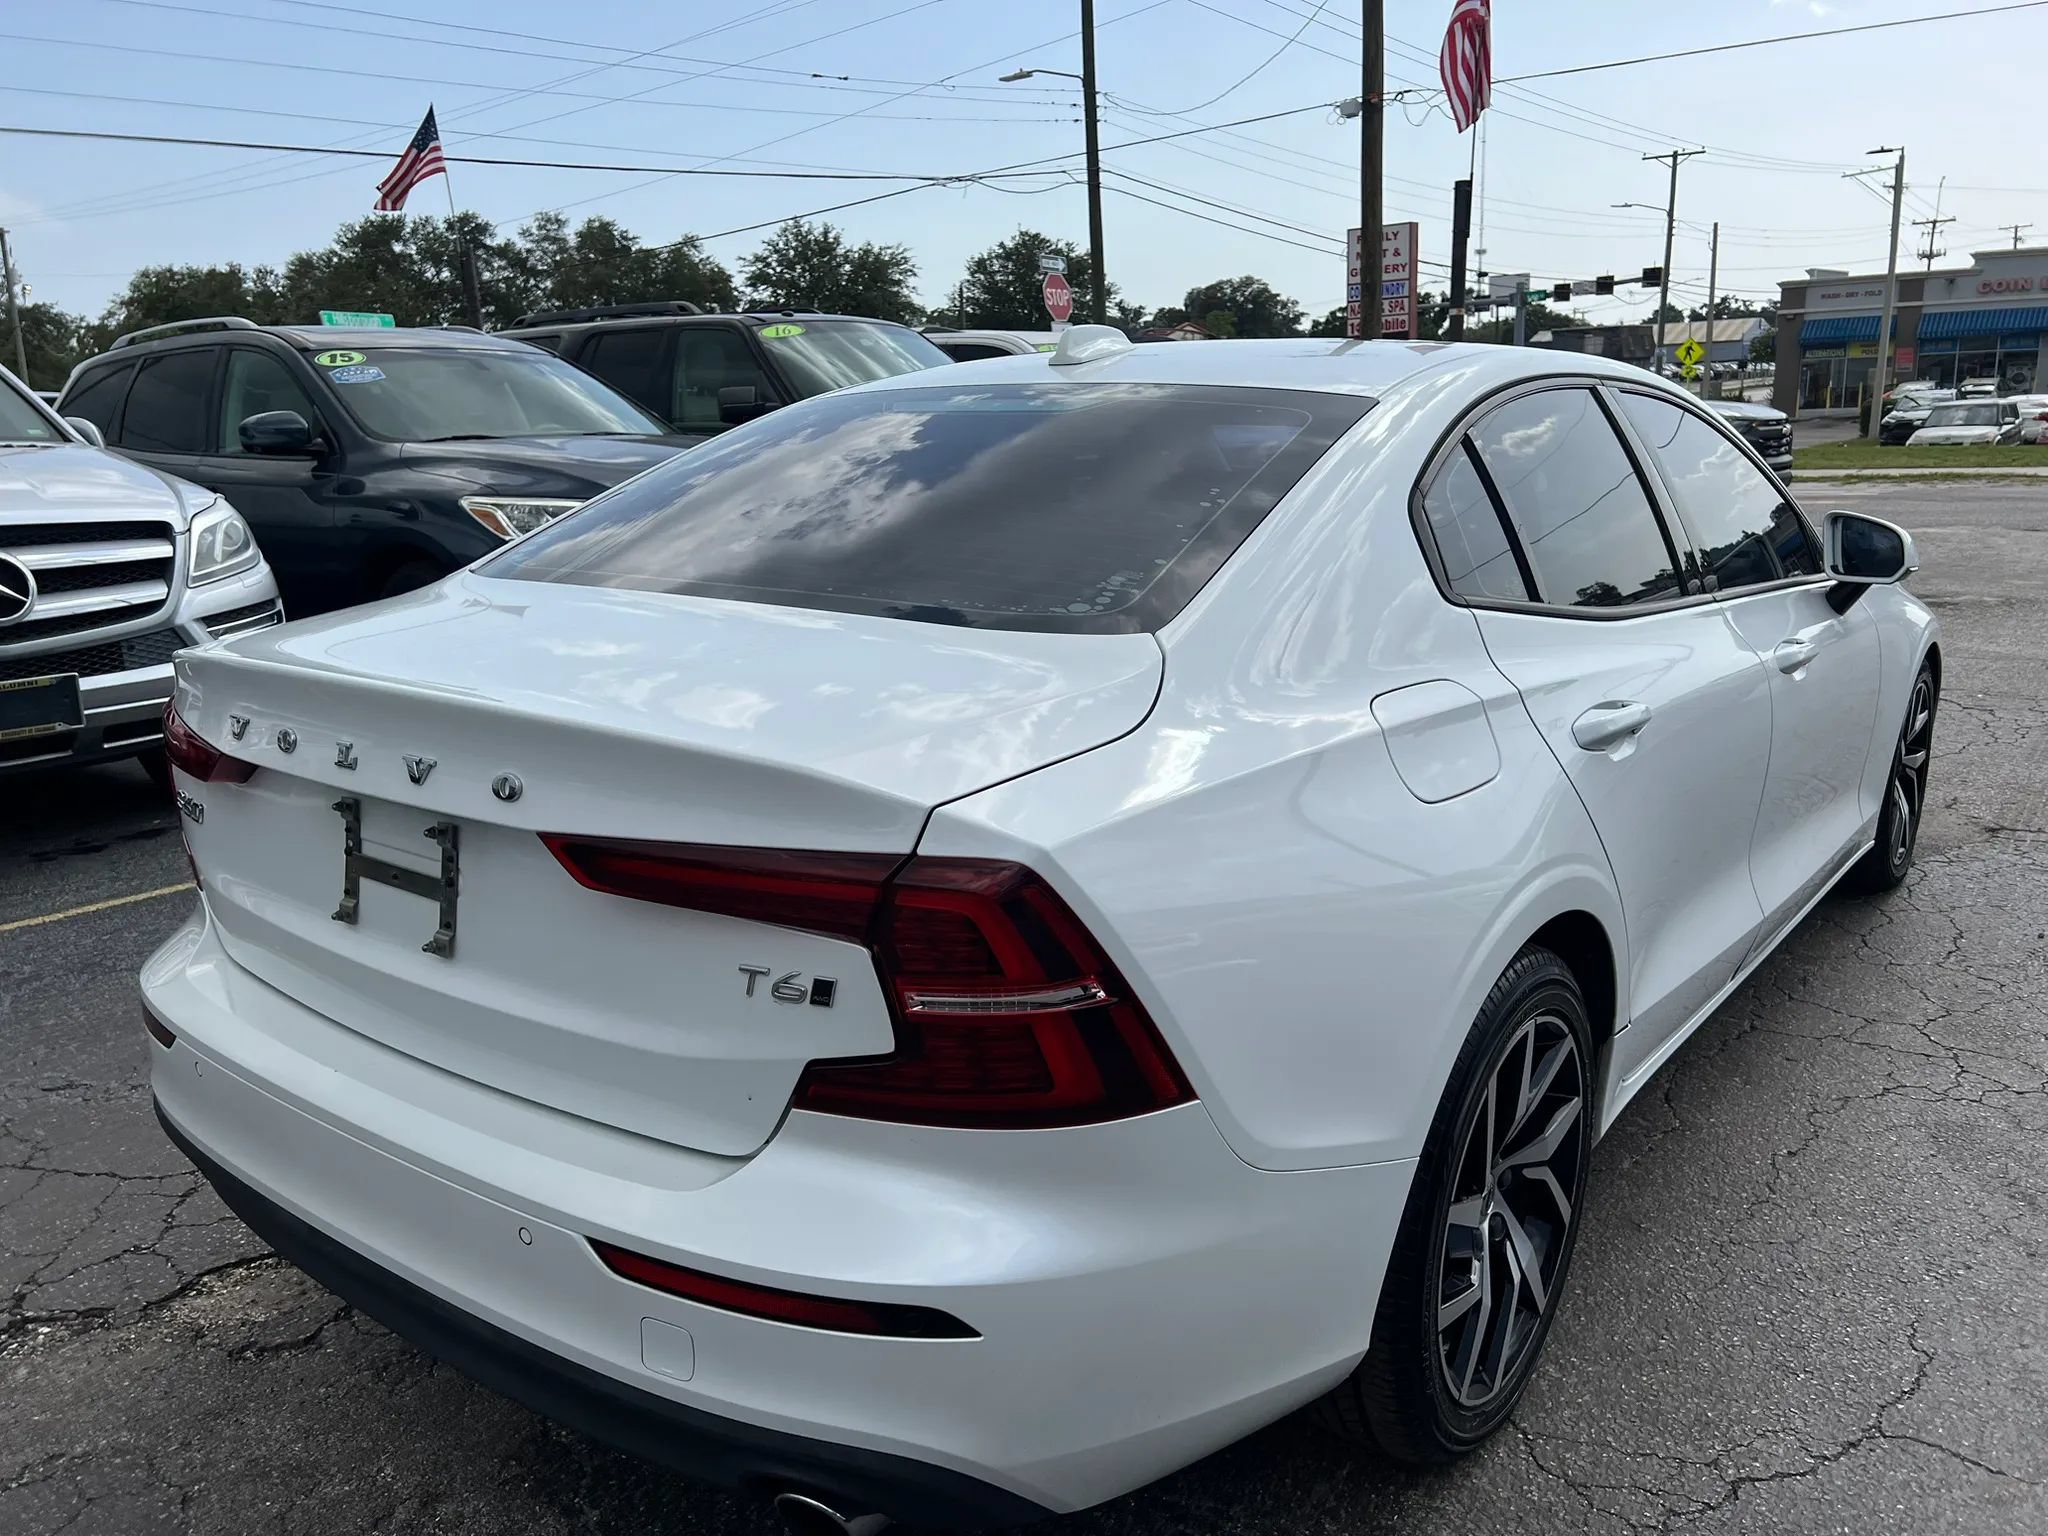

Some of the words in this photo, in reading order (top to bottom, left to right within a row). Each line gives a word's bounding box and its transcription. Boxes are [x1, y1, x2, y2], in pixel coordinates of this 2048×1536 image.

[1392, 247, 1402, 257] &
[1350, 263, 1408, 277] GERY
[1977, 278, 2033, 293] COIN
[1046, 288, 1070, 306] STOP
[1387, 299, 1405, 313] SPA
[775, 327, 791, 336] 16
[327, 353, 354, 364] 15
[228, 713, 524, 803] VOLVO
[738, 963, 808, 1004] T6
